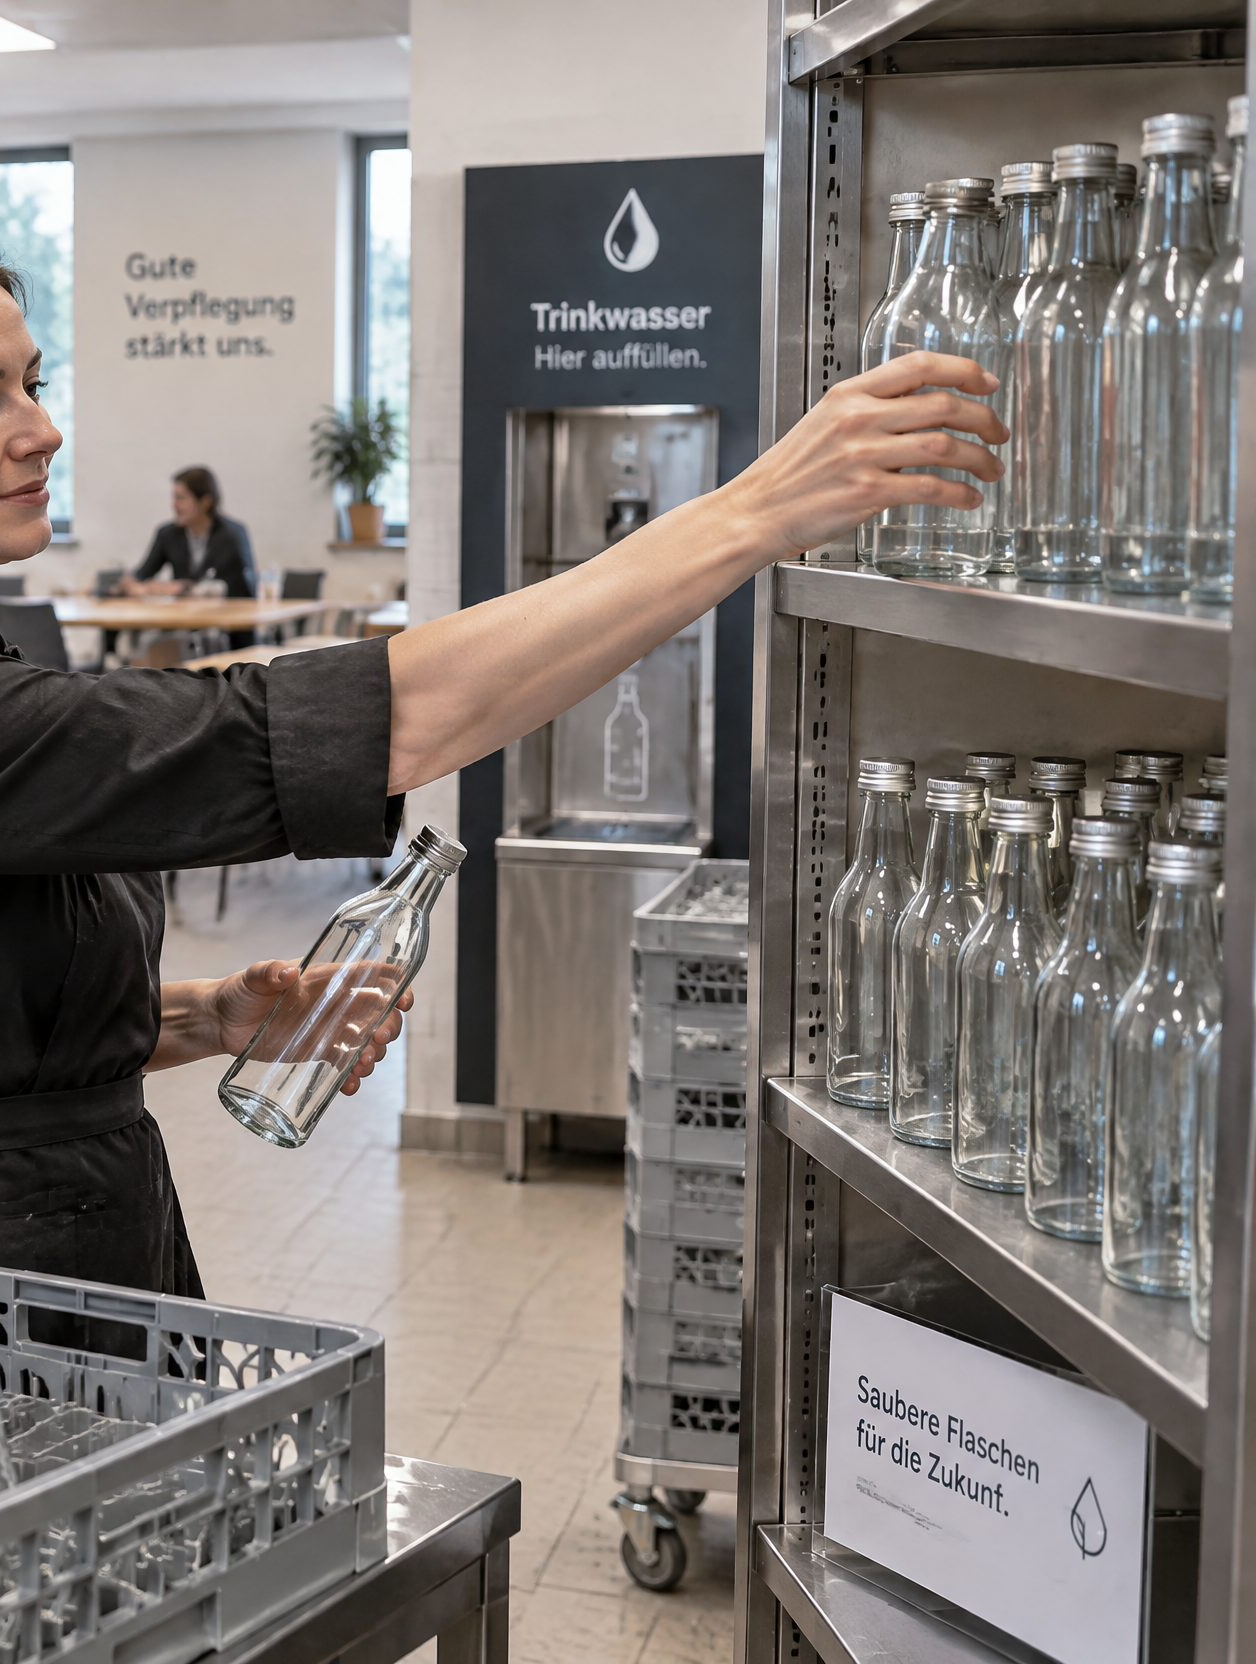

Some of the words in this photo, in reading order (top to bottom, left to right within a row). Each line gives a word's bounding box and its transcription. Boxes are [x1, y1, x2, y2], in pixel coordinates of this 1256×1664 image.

[125, 252, 197, 281] Gute
[124, 289, 295, 325] Verpflegung
[530, 300, 712, 332] Trinkwasser
[125, 330, 207, 360] stärkt
[216, 336, 274, 358] uns.
[534, 344, 587, 370] Hier
[592, 341, 707, 370] auffüllen.
[856, 1418, 886, 1456] für
[891, 1436, 922, 1473] die
[857, 1375, 940, 1436] Saubere
[947, 1414, 1040, 1484] Flaschen
